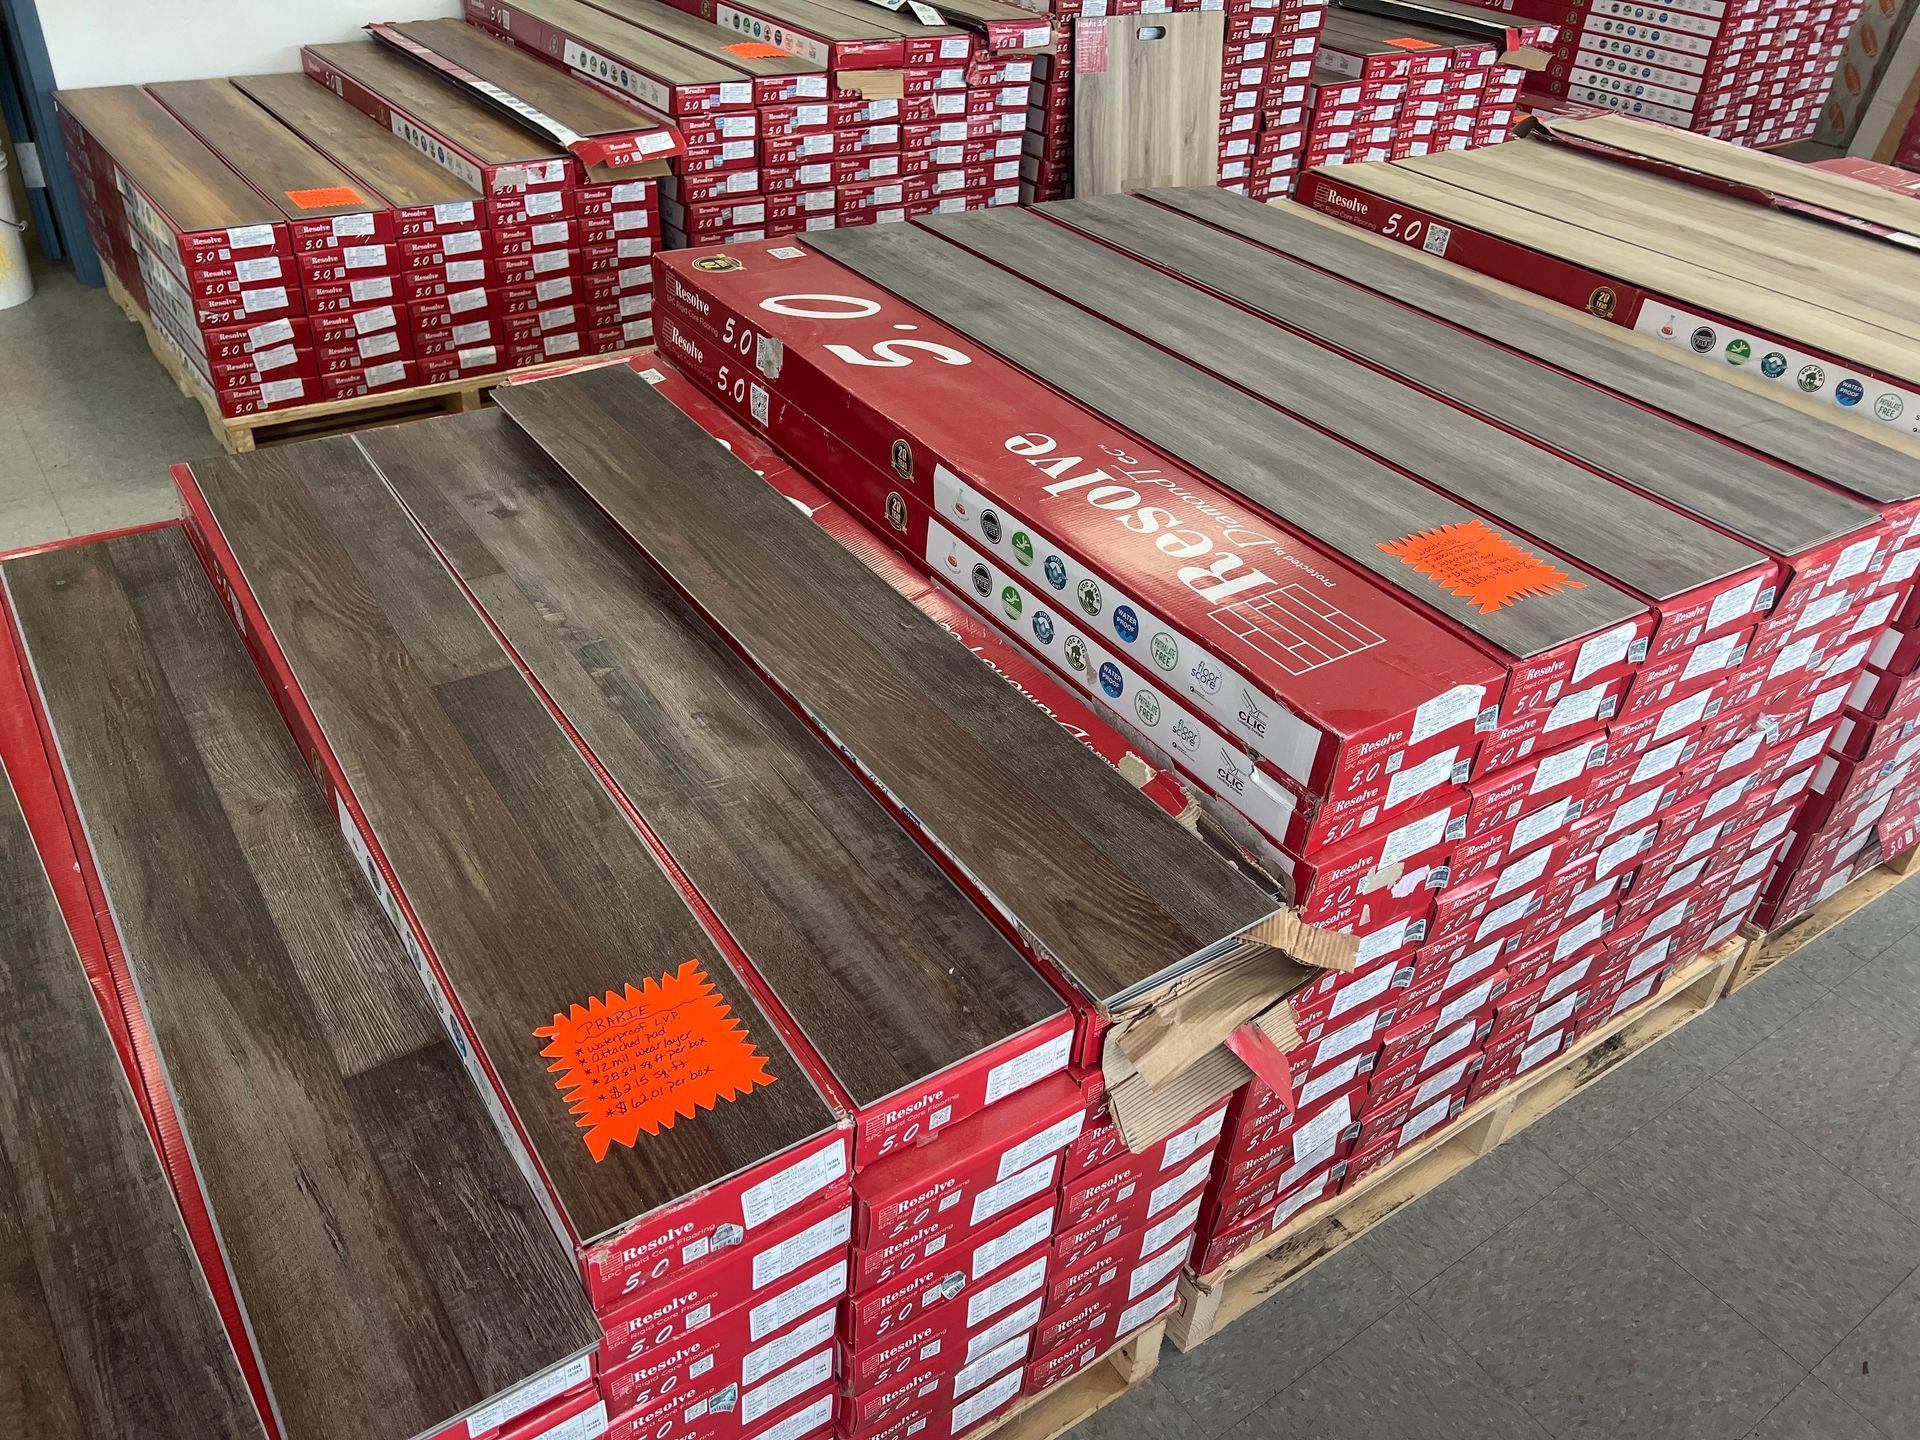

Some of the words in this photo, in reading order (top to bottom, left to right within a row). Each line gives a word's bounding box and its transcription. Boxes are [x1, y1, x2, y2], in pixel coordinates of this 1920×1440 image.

[615, 154, 629, 164] 5.0
[1328, 189, 1368, 215] Resolve
[1382, 213, 1422, 242] 5.0
[193, 237, 222, 245] Resolve
[305, 239, 323, 250] 5.0
[203, 269, 232, 278] Resolve
[205, 284, 224, 294] 5.0
[675, 279, 710, 316] Resolve
[1598, 291, 1610, 303] 20
[722, 317, 752, 355] 5.0
[759, 294, 972, 368] 5.0
[221, 346, 240, 357] 5.0
[672, 326, 704, 364] Resolve
[717, 365, 745, 403] 5.0
[1839, 387, 1859, 398] PROOF
[1842, 381, 1862, 392] WATER
[1878, 406, 1895, 417] FREE
[898, 446, 906, 461] 20
[892, 498, 901, 514] 20
[1003, 431, 1281, 607] Resolve
[1271, 545, 1286, 557] by
[1284, 554, 1337, 589] Protected
[1116, 618, 1135, 632] PROOF
[1118, 608, 1137, 626] WATER
[1673, 605, 1706, 625] Resolve
[1657, 634, 1684, 656] 5.0
[1154, 650, 1171, 667] FREE
[1197, 661, 1219, 681] floor
[1526, 658, 1565, 681] Resolve
[1102, 672, 1120, 689] PROOF
[1103, 664, 1122, 681] WATER
[1191, 668, 1216, 690] score
[1647, 661, 1679, 683] Resolve
[1138, 706, 1154, 723] FREE
[1512, 690, 1542, 715] 5.0
[1631, 691, 1657, 712] 5.0
[1178, 719, 1197, 738] floor
[1238, 710, 1265, 734] CLIC
[1499, 717, 1537, 741] Resolve
[1172, 726, 1195, 747] score
[1359, 731, 1403, 755] Resolve
[1485, 748, 1515, 771] 5.0
[1218, 768, 1243, 792] CLIC
[1348, 762, 1380, 791] 5.0
[1335, 786, 1379, 812] Resolve
[1486, 781, 1523, 804] Resolve
[1322, 818, 1355, 845] 5.0
[1474, 810, 1503, 835] 5.0
[1331, 855, 1373, 881] Resolve
[1320, 886, 1351, 912] 5.0
[577, 1004, 650, 1036] PRARIE
[644, 1027, 666, 1043] pad
[597, 1062, 613, 1074] 12
[612, 1054, 629, 1069] mil
[635, 1041, 661, 1058] wear
[663, 1030, 693, 1049] layer
[668, 1045, 685, 1061] per
[688, 1037, 707, 1052] box
[666, 1078, 685, 1091] per
[689, 1066, 714, 1081] box
[671, 1060, 688, 1071] ft
[866, 1131, 883, 1143] SPC
[885, 1119, 906, 1134] Rigid
[907, 1111, 927, 1123] Core
[928, 1093, 959, 1112] Flooring
[885, 1089, 944, 1125] Resolve
[878, 1123, 919, 1155] 5.0
[1083, 1138, 1116, 1168] 5.0
[898, 1178, 956, 1214] Resolve
[1084, 1168, 1132, 1200] Resolve
[889, 1209, 930, 1238] 5.0
[1076, 1197, 1110, 1224] 5.0
[883, 1223, 939, 1258] Resolve
[1074, 1212, 1118, 1244] Resolve
[602, 1269, 621, 1283] SPC
[624, 1255, 649, 1271] Rigid
[652, 1245, 675, 1258] Core
[677, 1223, 715, 1247] Flooring
[623, 1222, 695, 1263] Resolve
[1066, 1241, 1097, 1268] 5.0
[622, 1258, 670, 1295] 5.0
[877, 1253, 915, 1284] 5.0
[1068, 1255, 1112, 1287] Resolve
[880, 1272, 934, 1308] Resolve
[1060, 1282, 1092, 1308] 5.0
[608, 1338, 627, 1351] SPC
[630, 1324, 655, 1340] Rigid
[657, 1313, 679, 1326] Core
[681, 1290, 718, 1314] Flooring
[628, 1290, 698, 1332] Resolve
[877, 1303, 912, 1335] 5.0
[627, 1325, 673, 1359] 5.0
[879, 1327, 932, 1363] Resolve
[1049, 1337, 1091, 1369] Resolve
[633, 1342, 701, 1383] Resolve
[874, 1357, 911, 1386] 5.0
[633, 1376, 677, 1410] 5.0
[881, 1371, 933, 1406] Resolve
[631, 1387, 696, 1430] Resolve
